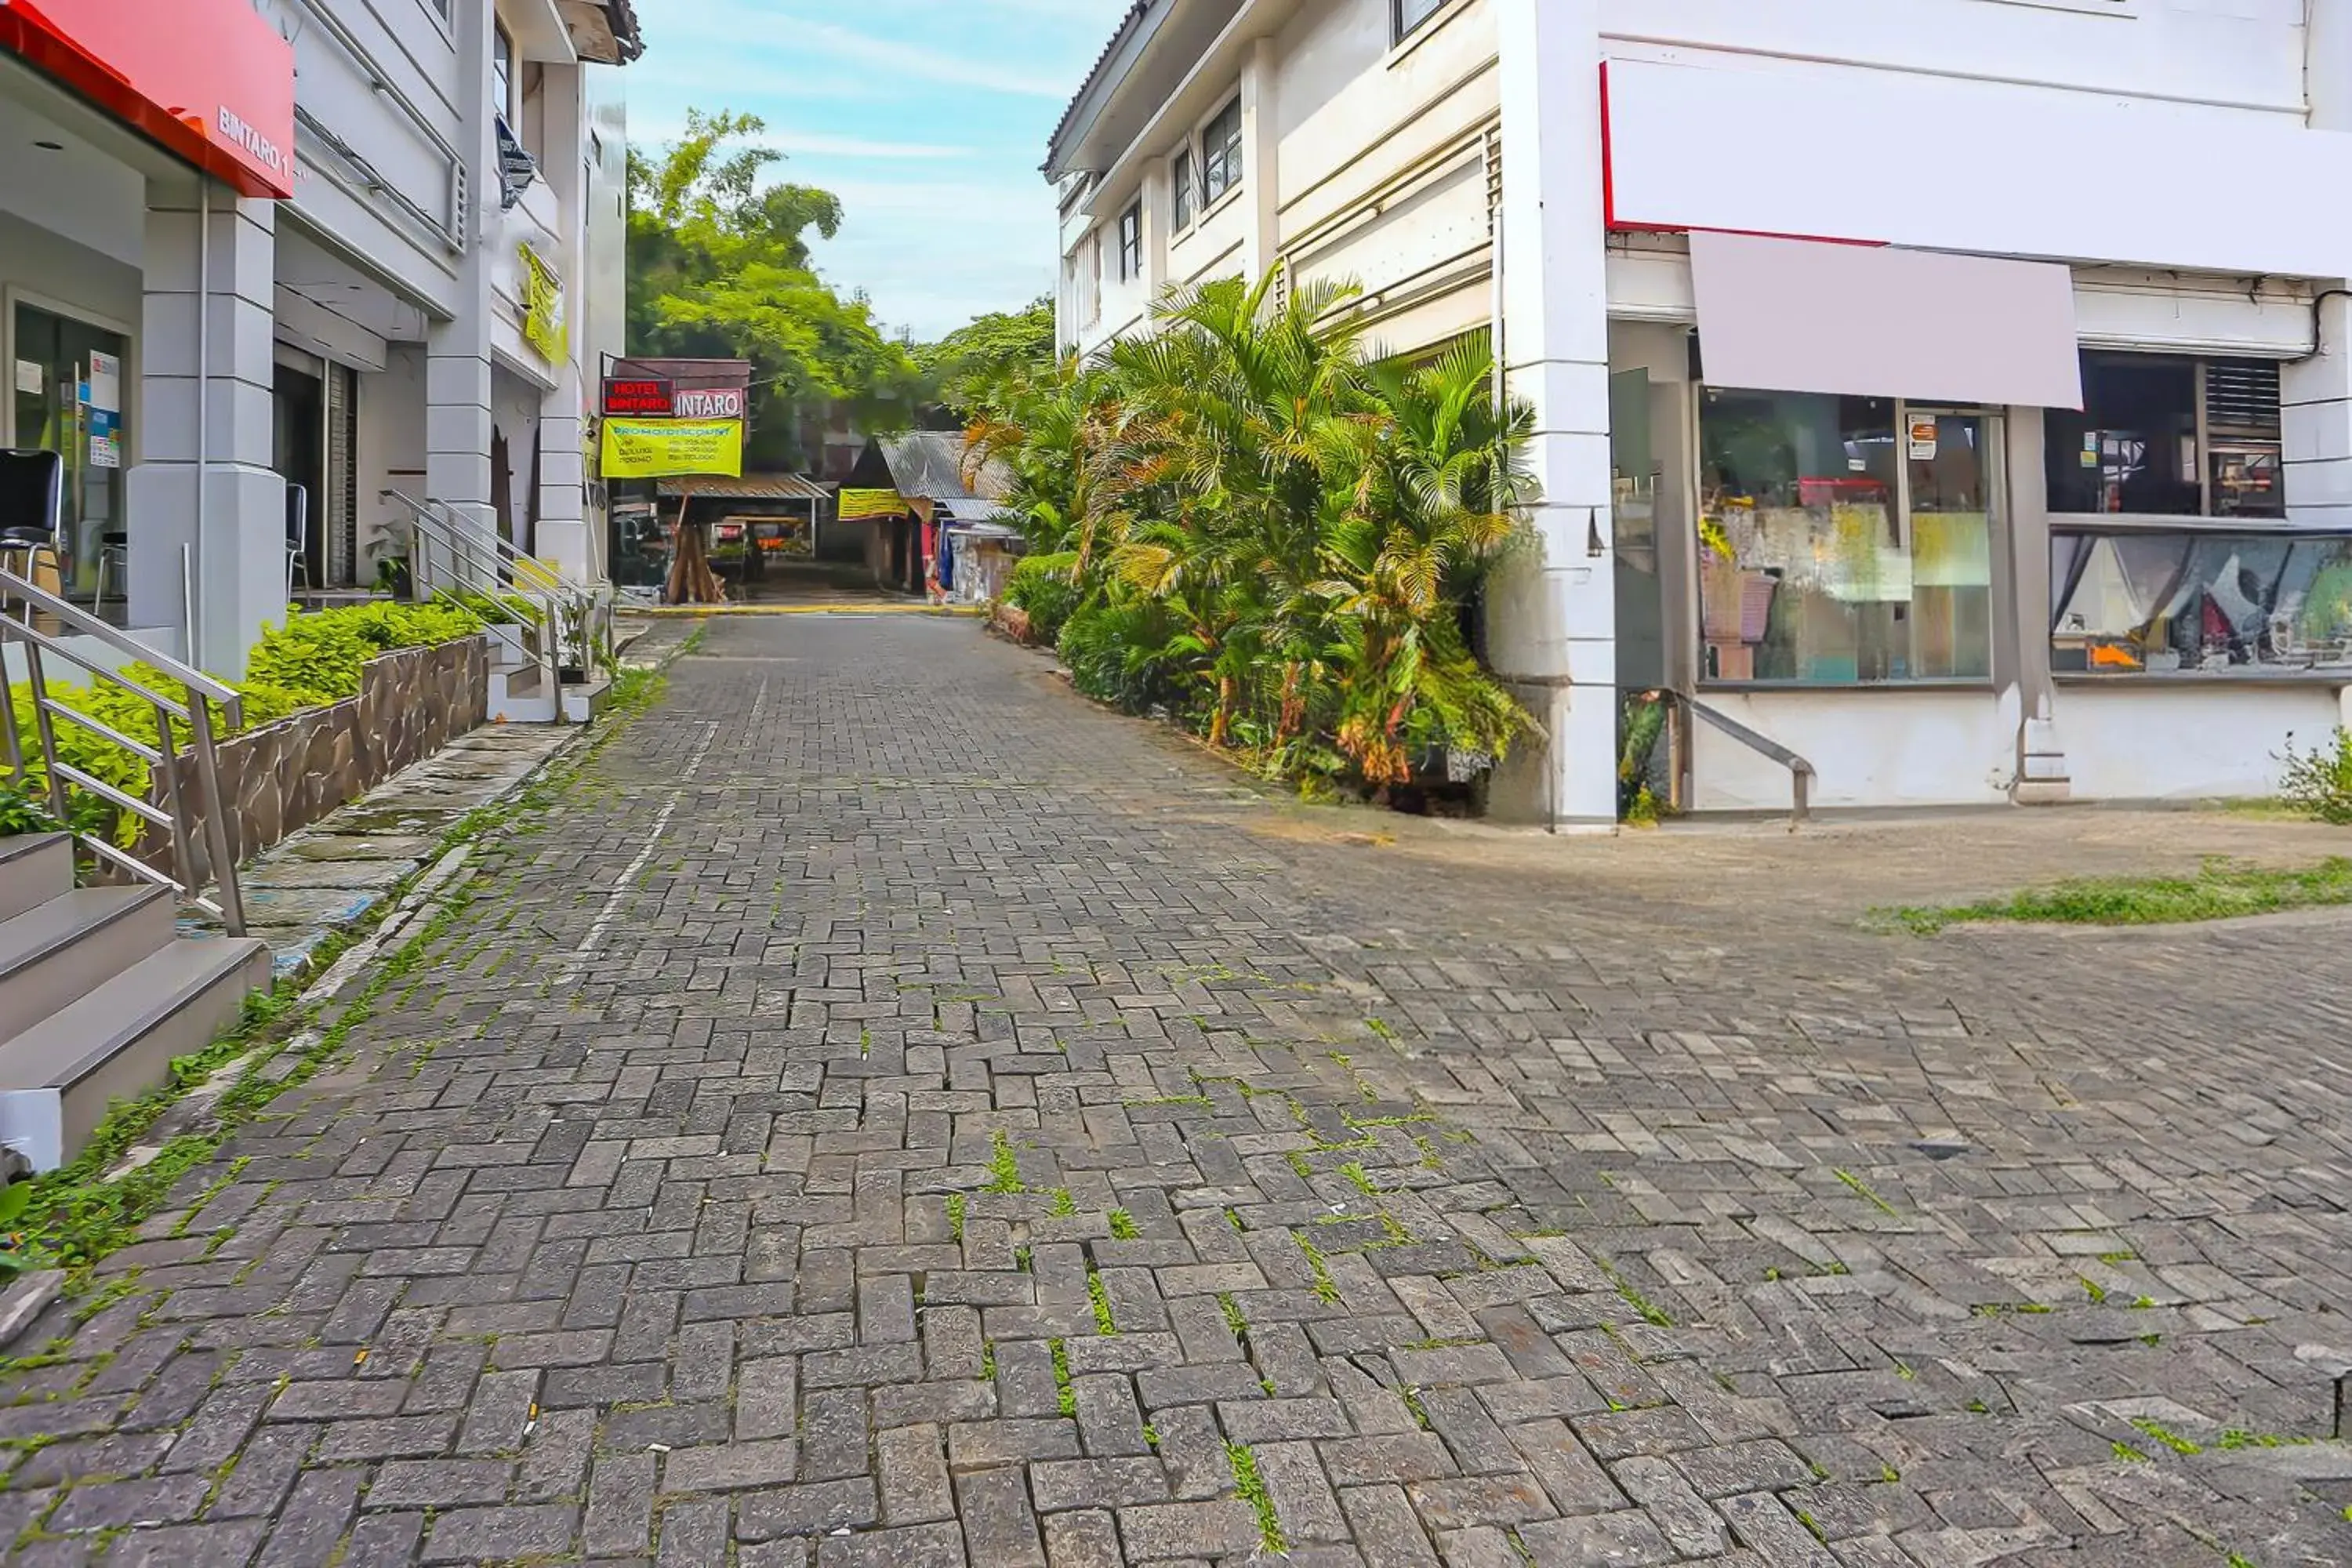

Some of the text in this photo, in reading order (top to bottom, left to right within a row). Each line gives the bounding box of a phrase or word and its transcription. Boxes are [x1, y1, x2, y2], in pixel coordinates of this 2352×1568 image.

[218, 103, 289, 178] BINTARO 1
[614, 382, 659, 394] HOTEL
[608, 397, 669, 409] BINTARO
[676, 394, 739, 416] INTARO
